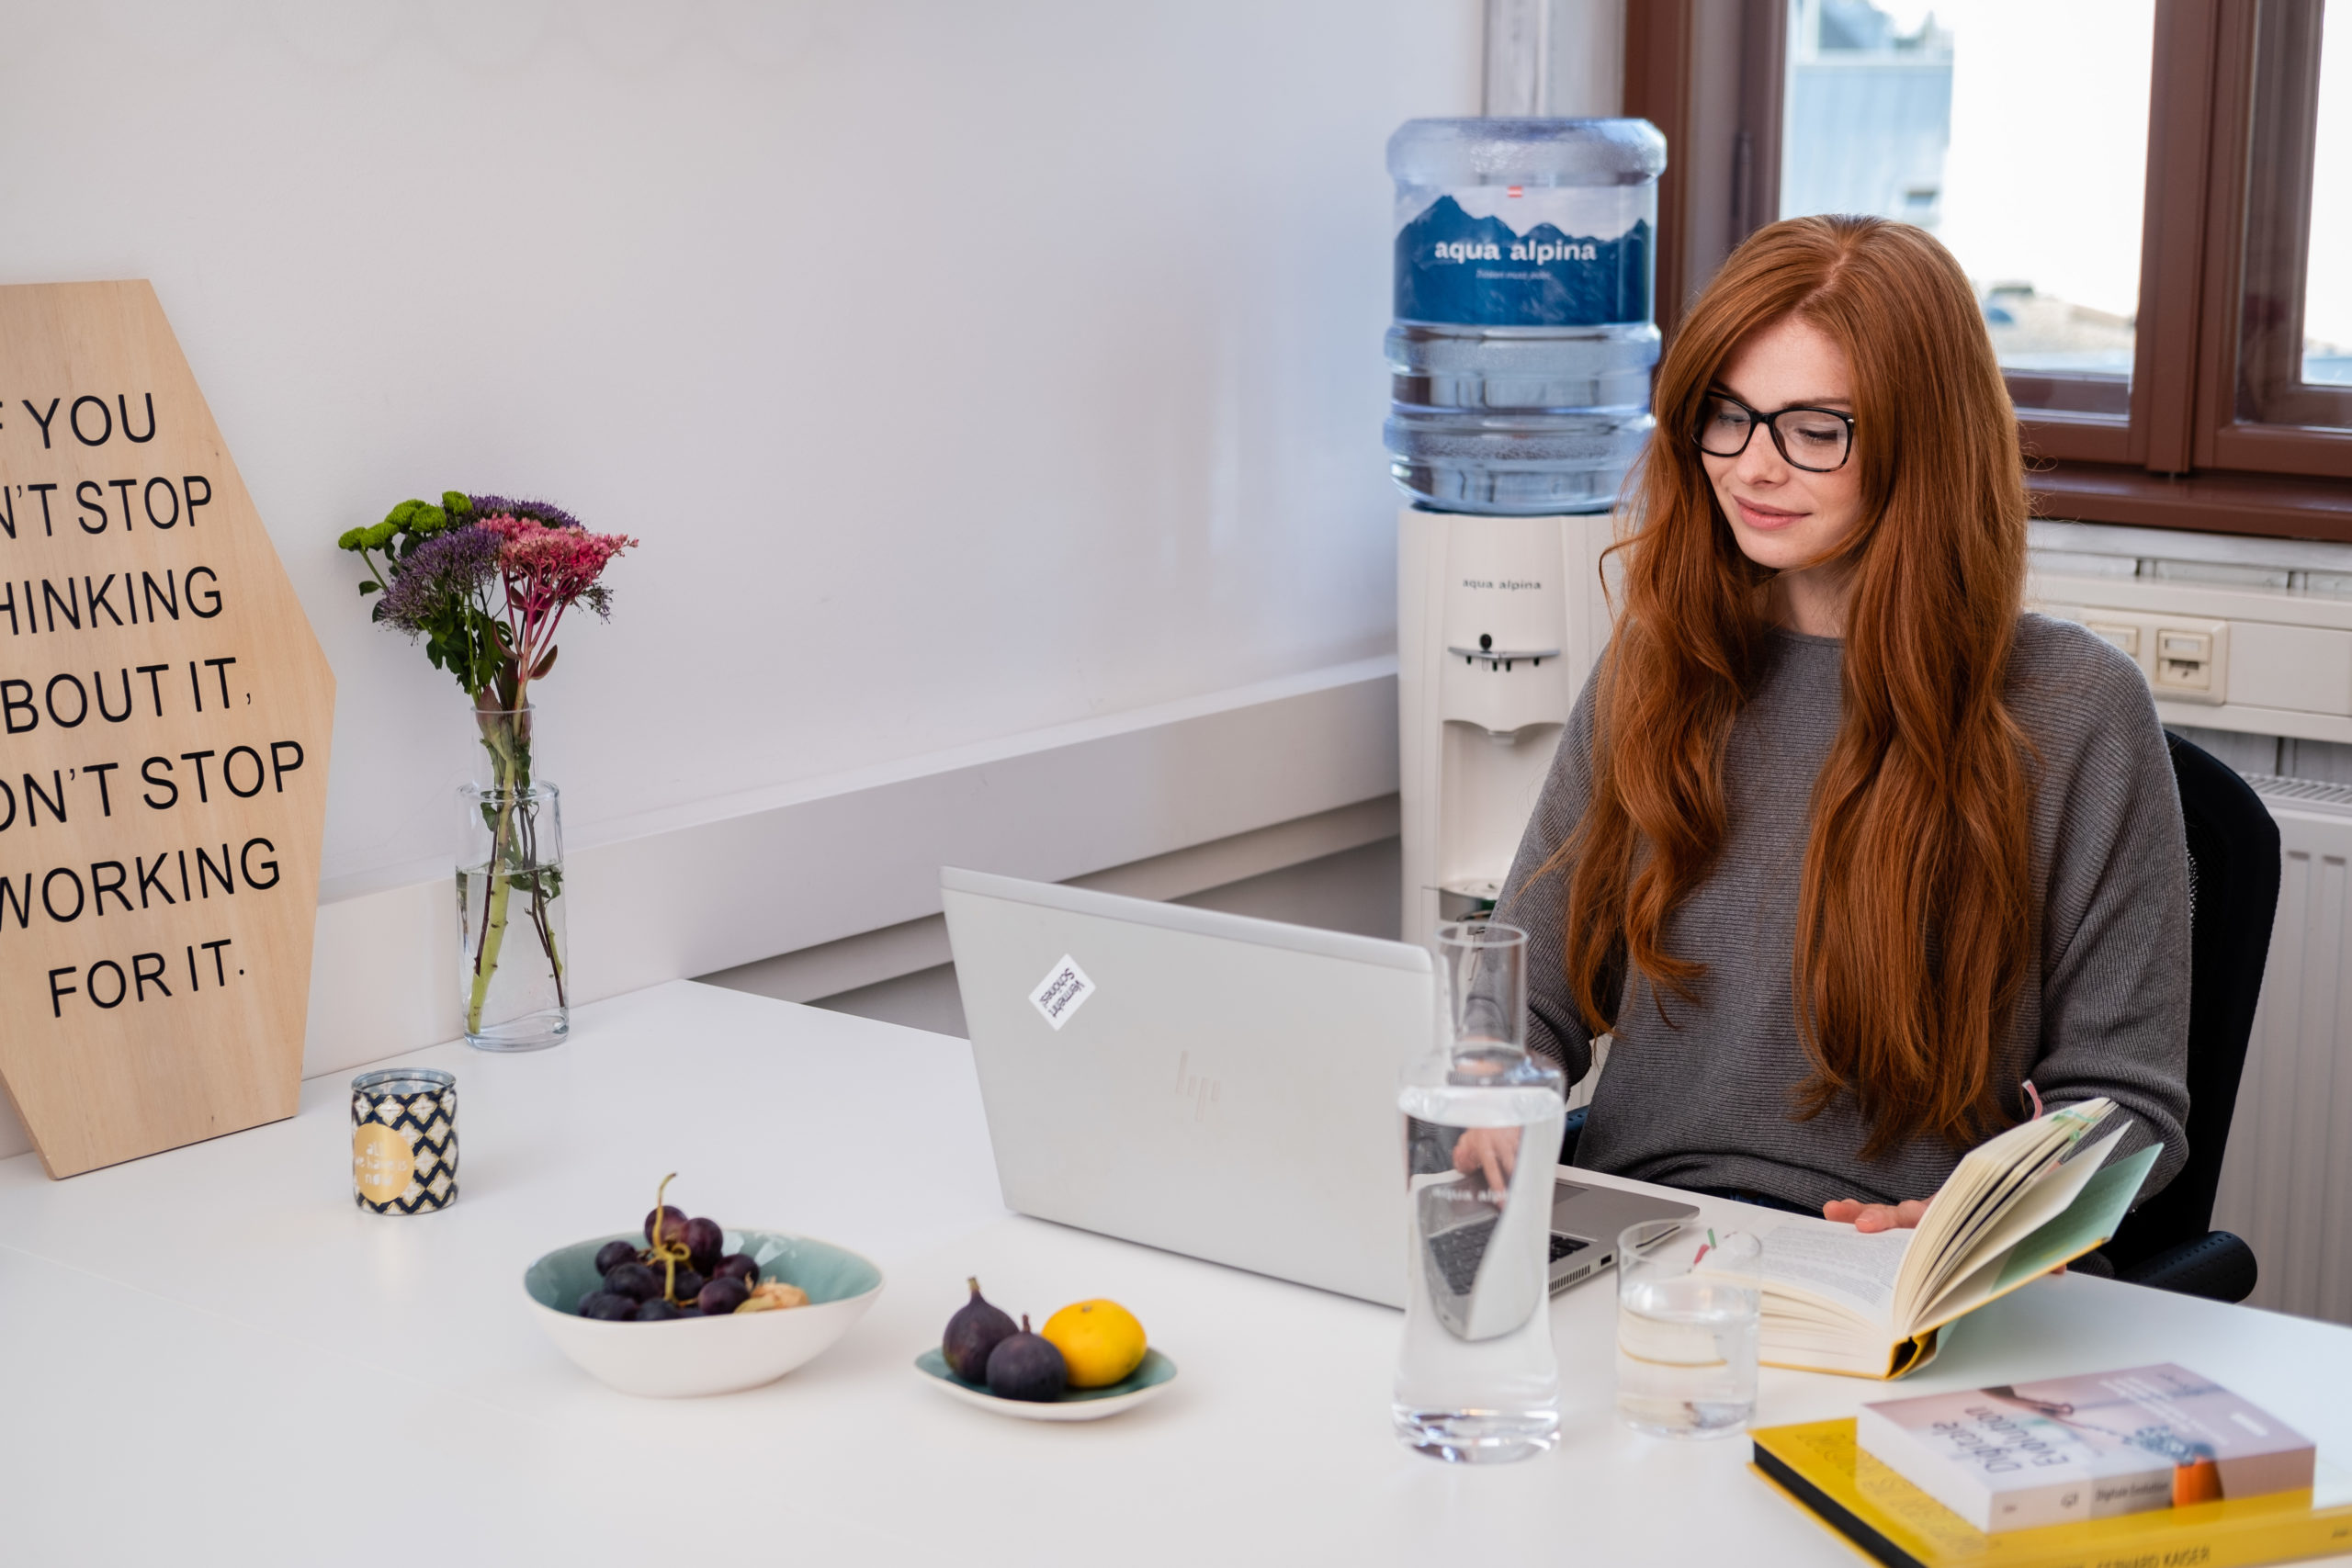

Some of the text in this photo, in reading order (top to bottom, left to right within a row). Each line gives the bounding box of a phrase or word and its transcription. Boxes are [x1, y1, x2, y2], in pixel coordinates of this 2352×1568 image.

[1435, 240, 1598, 265] aqua alpina
[22, 392, 156, 449] YOU
[76, 476, 212, 535] STOP
[1463, 580, 1542, 592] aqua alpina
[189, 657, 253, 713] IT,
[141, 740, 305, 810] STOP
[49, 939, 245, 1019] FOR IT.
